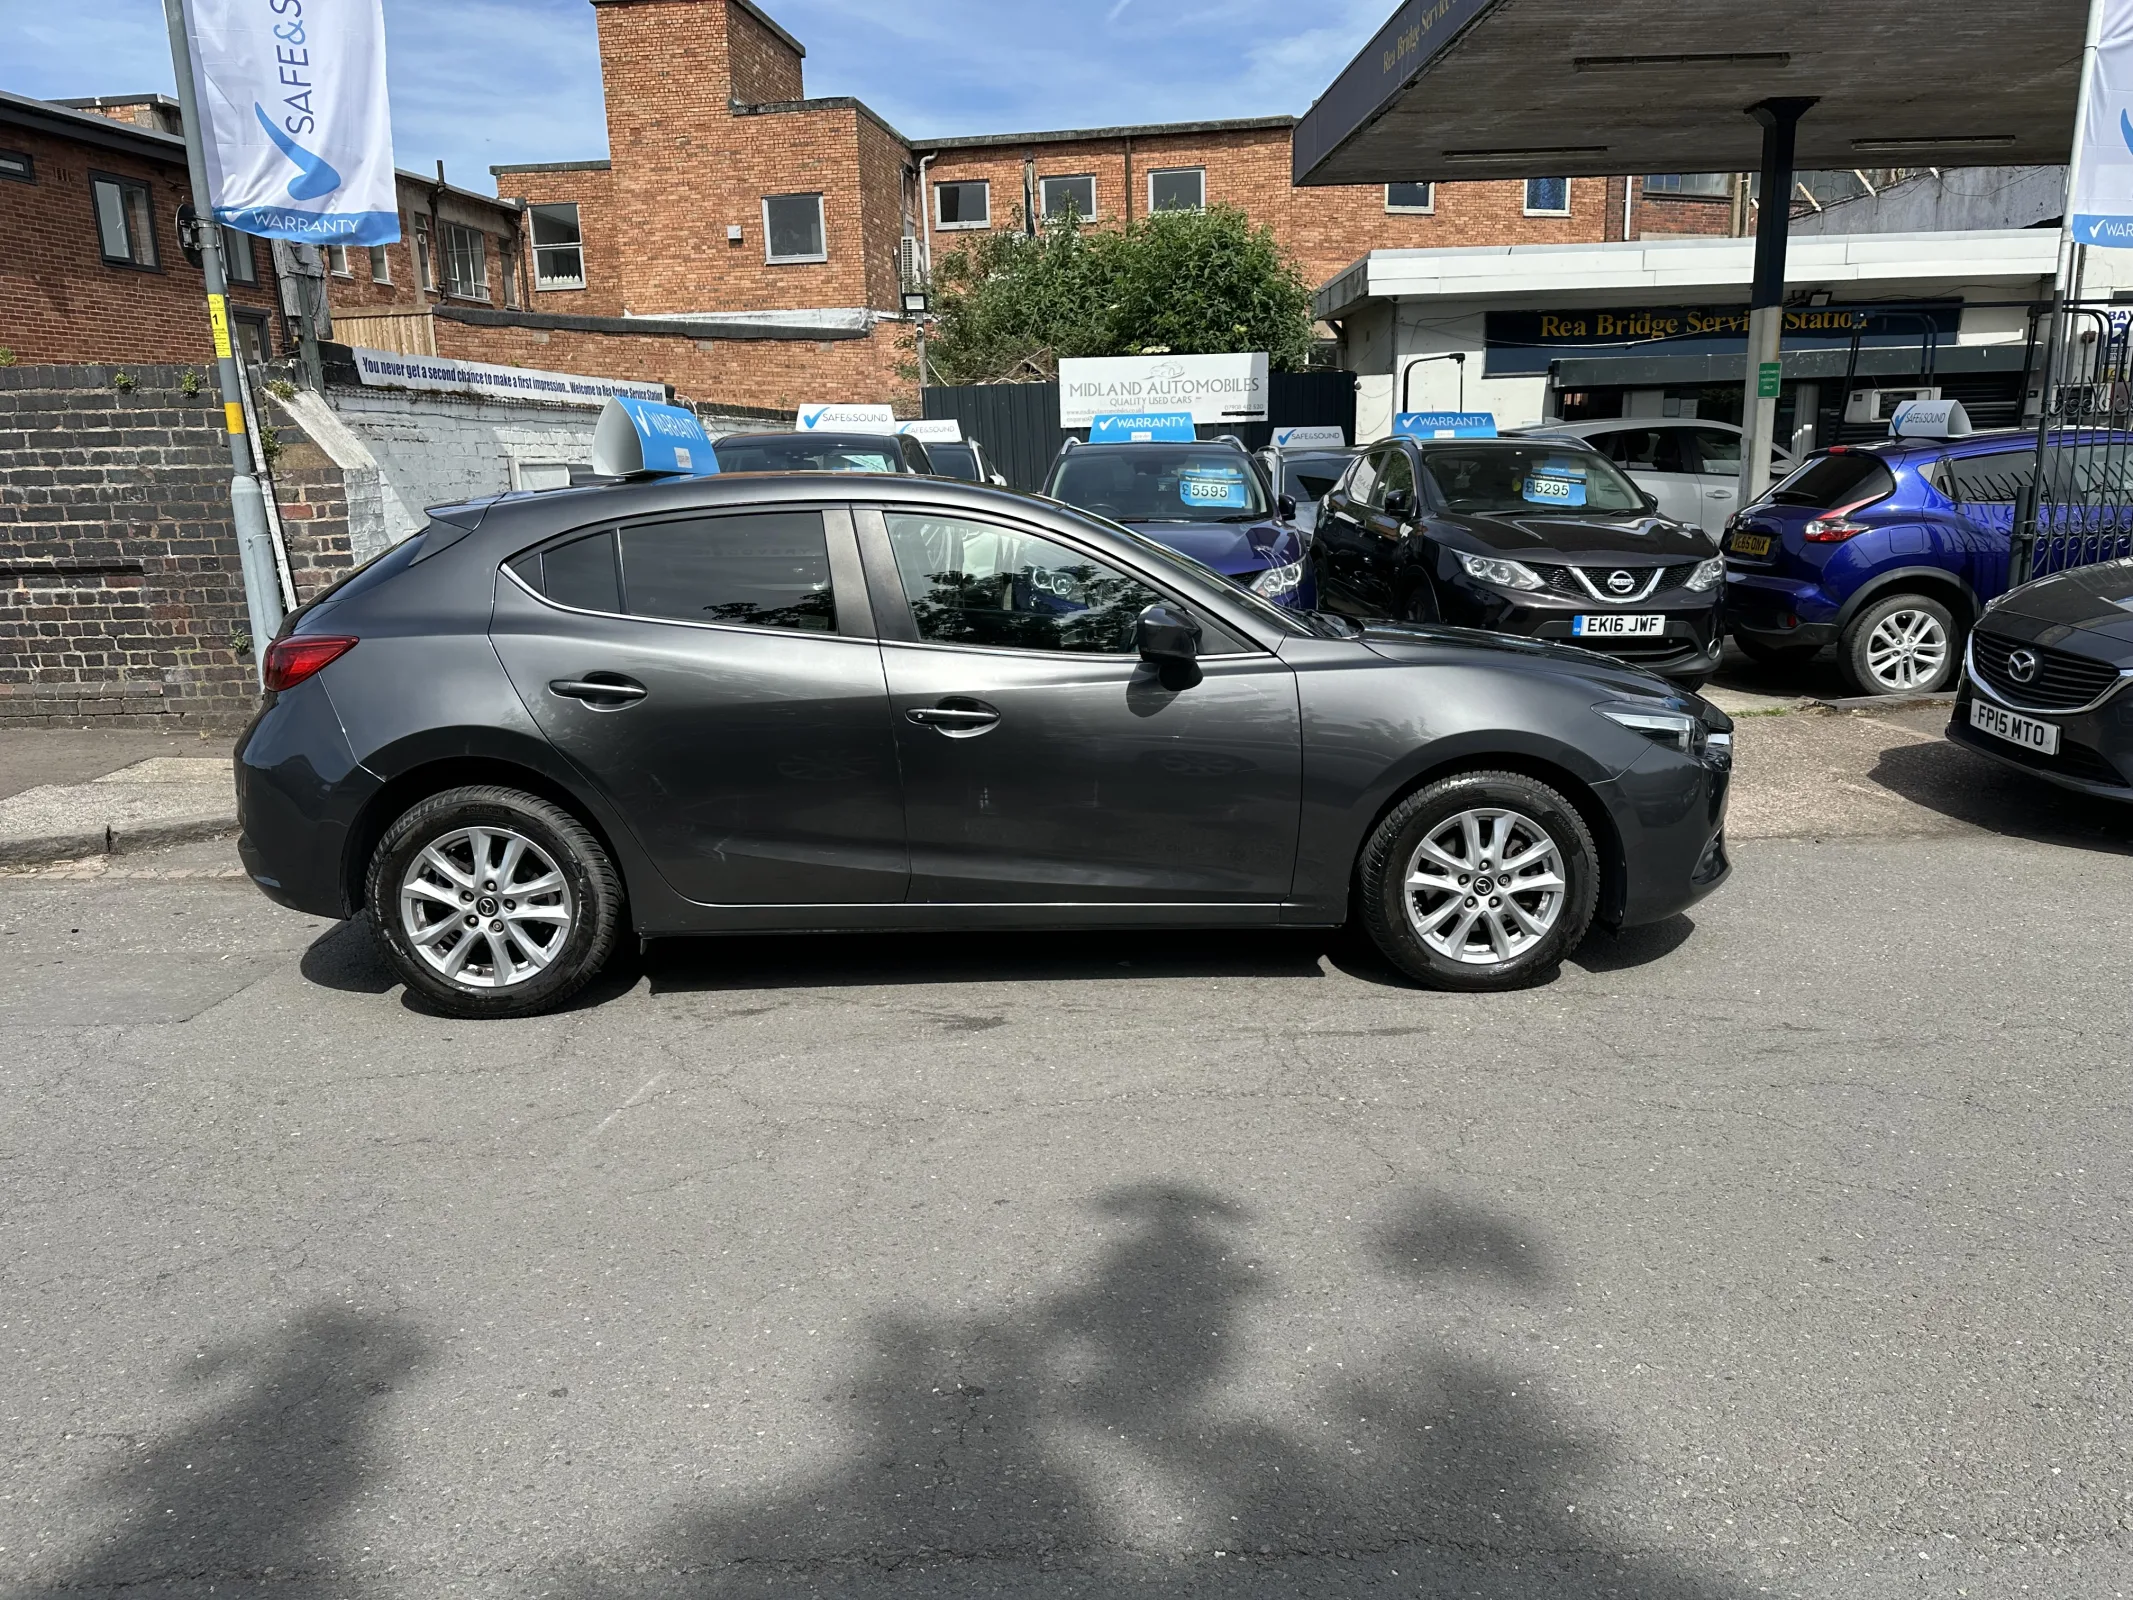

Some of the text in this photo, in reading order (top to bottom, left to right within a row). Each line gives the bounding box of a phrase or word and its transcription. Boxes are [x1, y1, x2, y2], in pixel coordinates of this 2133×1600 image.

[1383, 50, 1396, 74] Rea
[1397, 25, 1420, 60] Bridge
[253, 211, 359, 234] WARRANTY
[1540, 310, 1868, 339] Rea Bridge Servi Statio
[362, 357, 380, 374] You
[381, 361, 405, 377] never
[406, 364, 420, 379] get
[421, 367, 428, 379] a
[428, 366, 456, 382] second
[457, 369, 484, 385] chance
[484, 372, 493, 385] to
[493, 373, 512, 388] make
[513, 377, 518, 388] a
[518, 375, 532, 390] first
[569, 381, 596, 396] Welcome
[596, 384, 602, 396] to
[602, 384, 612, 397] Rea
[629, 387, 647, 400] Service
[646, 389, 664, 402] Station
[1068, 377, 1259, 397] MIDLAND AUTOMOBILES
[1109, 396, 1192, 407] QUALITY USED CARS
[644, 410, 704, 441] WARRANTY
[822, 413, 888, 423] SAFE&SOUND
[1116, 416, 1187, 428] WARRANTY
[1419, 416, 1488, 427] WARRANTY
[1904, 412, 1946, 424] SAFE&SOUND
[907, 425, 955, 434] SAFE&SOUND
[1291, 432, 1340, 440] SAFE&SOUND
[1587, 617, 1660, 632] EK16 JWF
[1977, 705, 2045, 746] FP15 MTO
